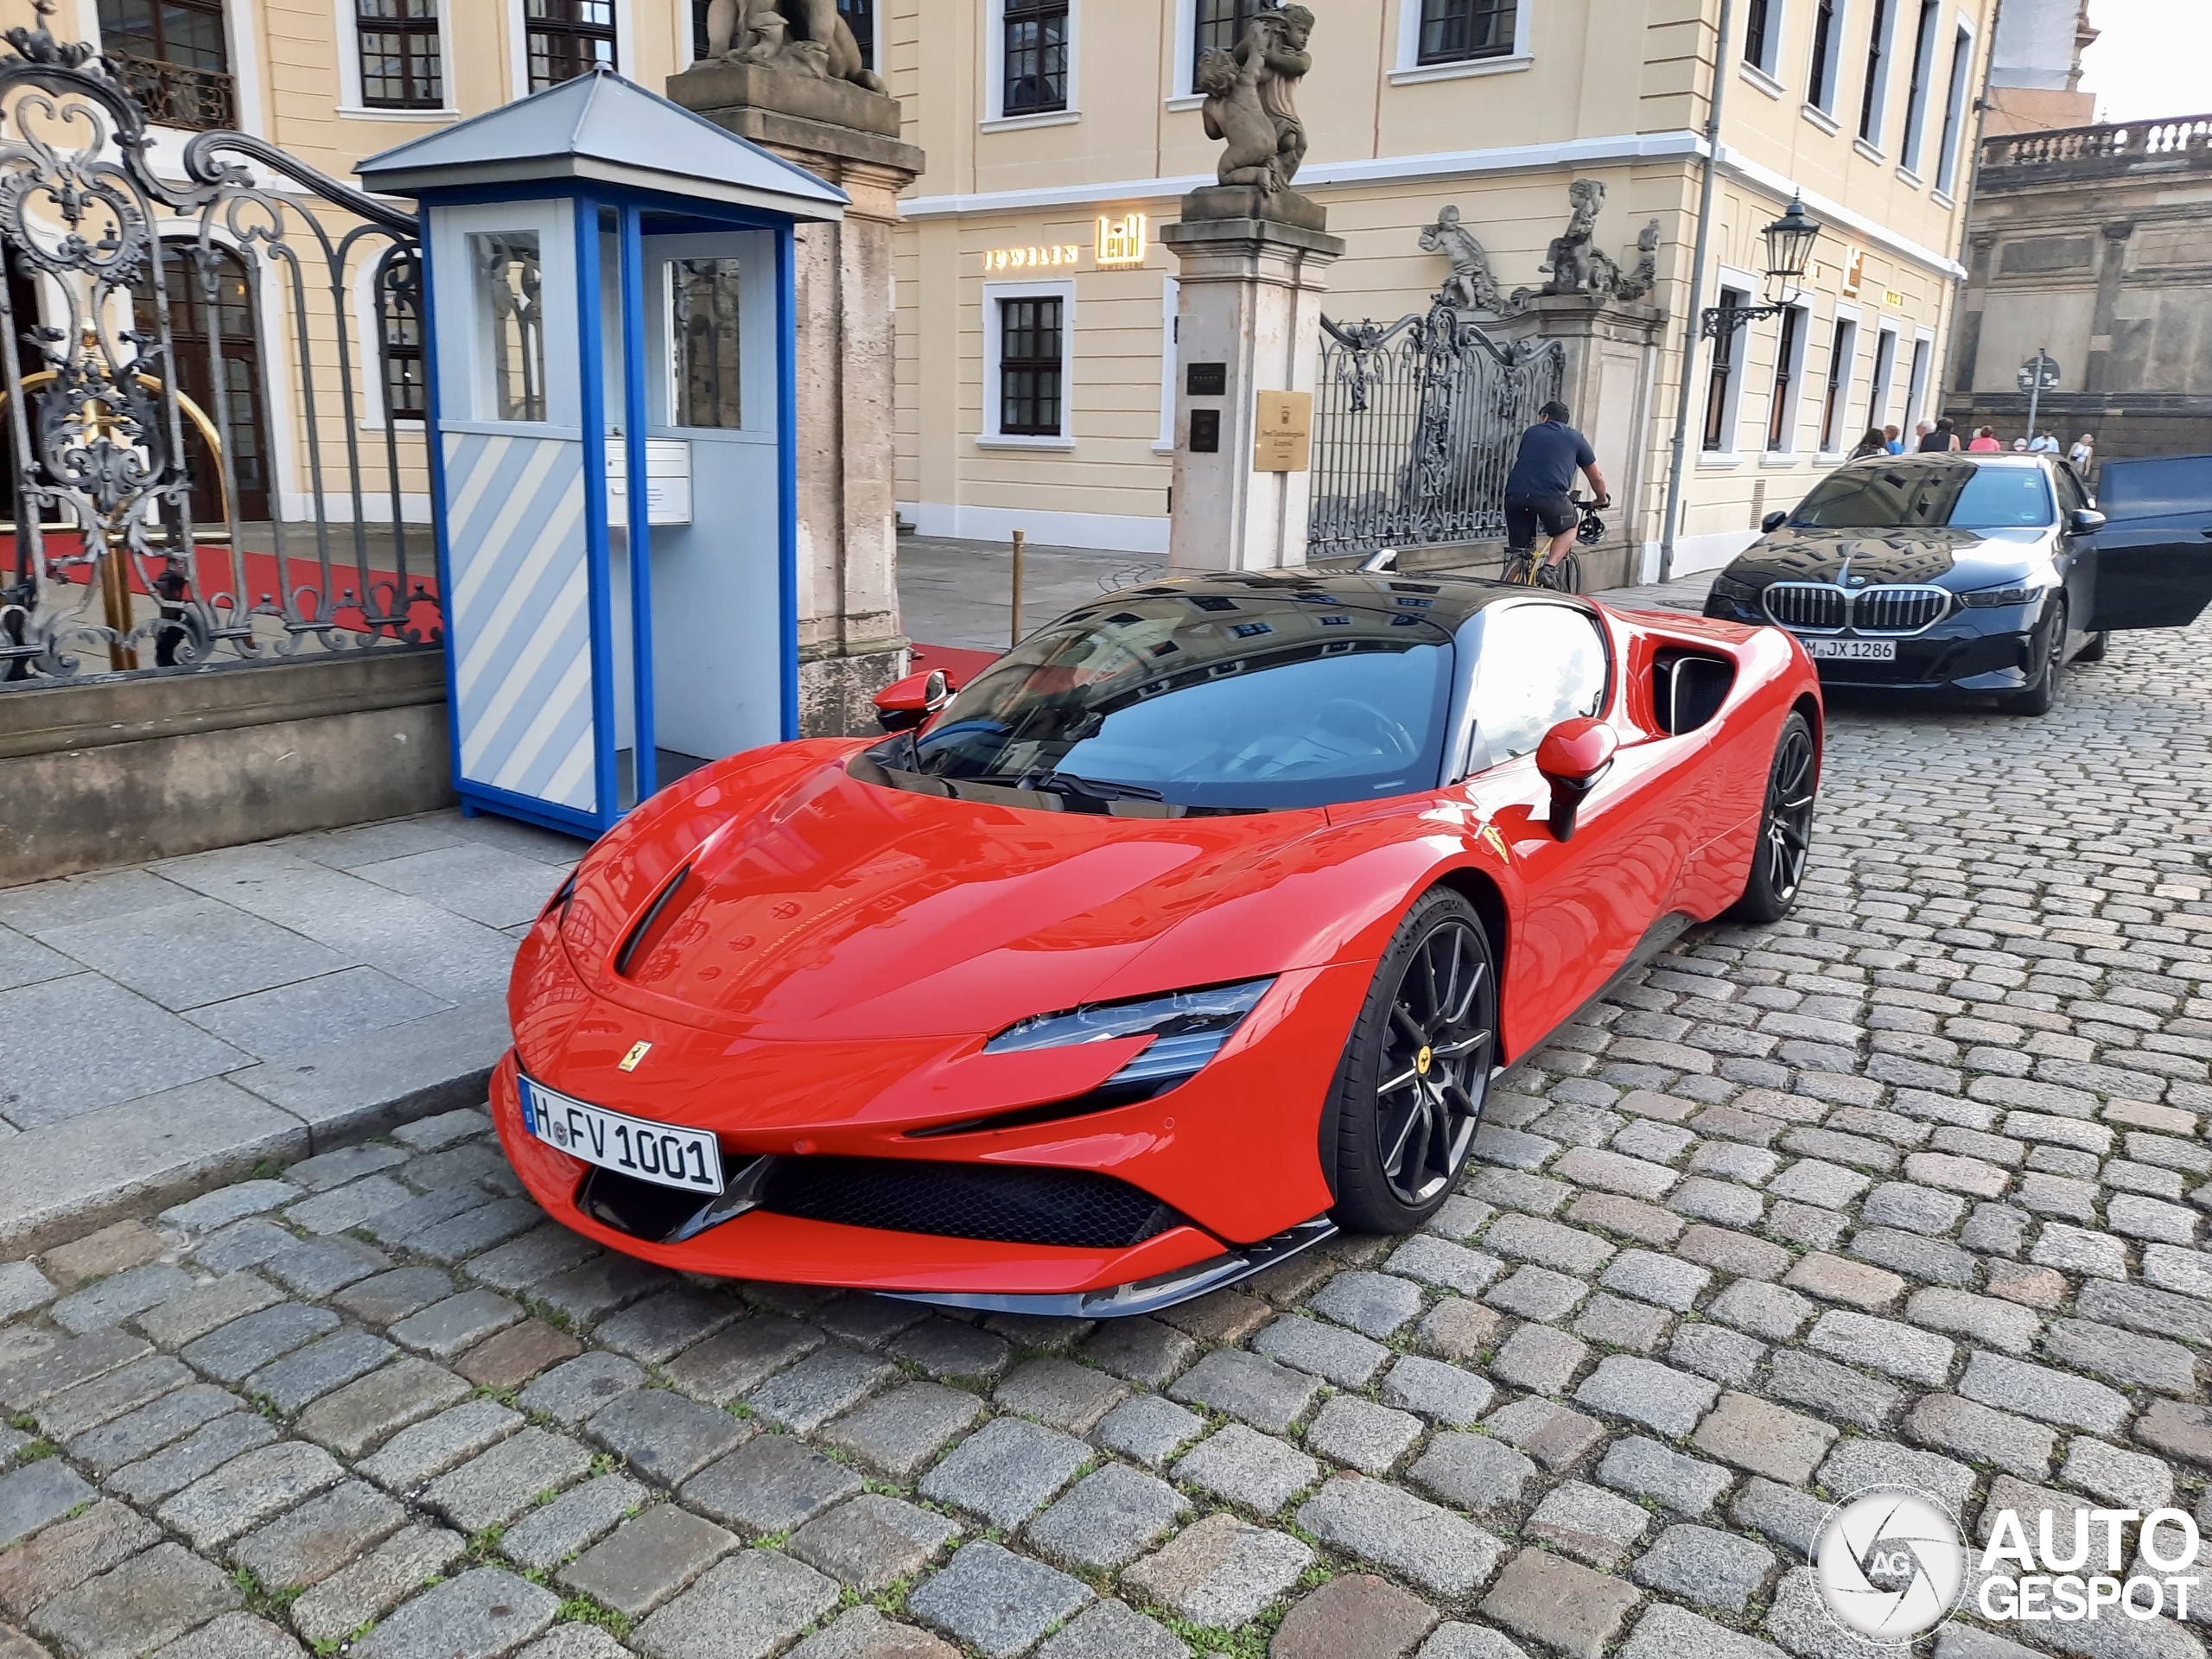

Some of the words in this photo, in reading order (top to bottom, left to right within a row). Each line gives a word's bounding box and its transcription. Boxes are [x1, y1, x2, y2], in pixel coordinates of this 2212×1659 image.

[1806, 642, 1816, 655] M
[1827, 642, 1847, 657] JX
[1851, 643, 1892, 658] 1286
[532, 1092, 551, 1138] H
[567, 1108, 604, 1158] FV
[615, 1125, 714, 1185] 1001
